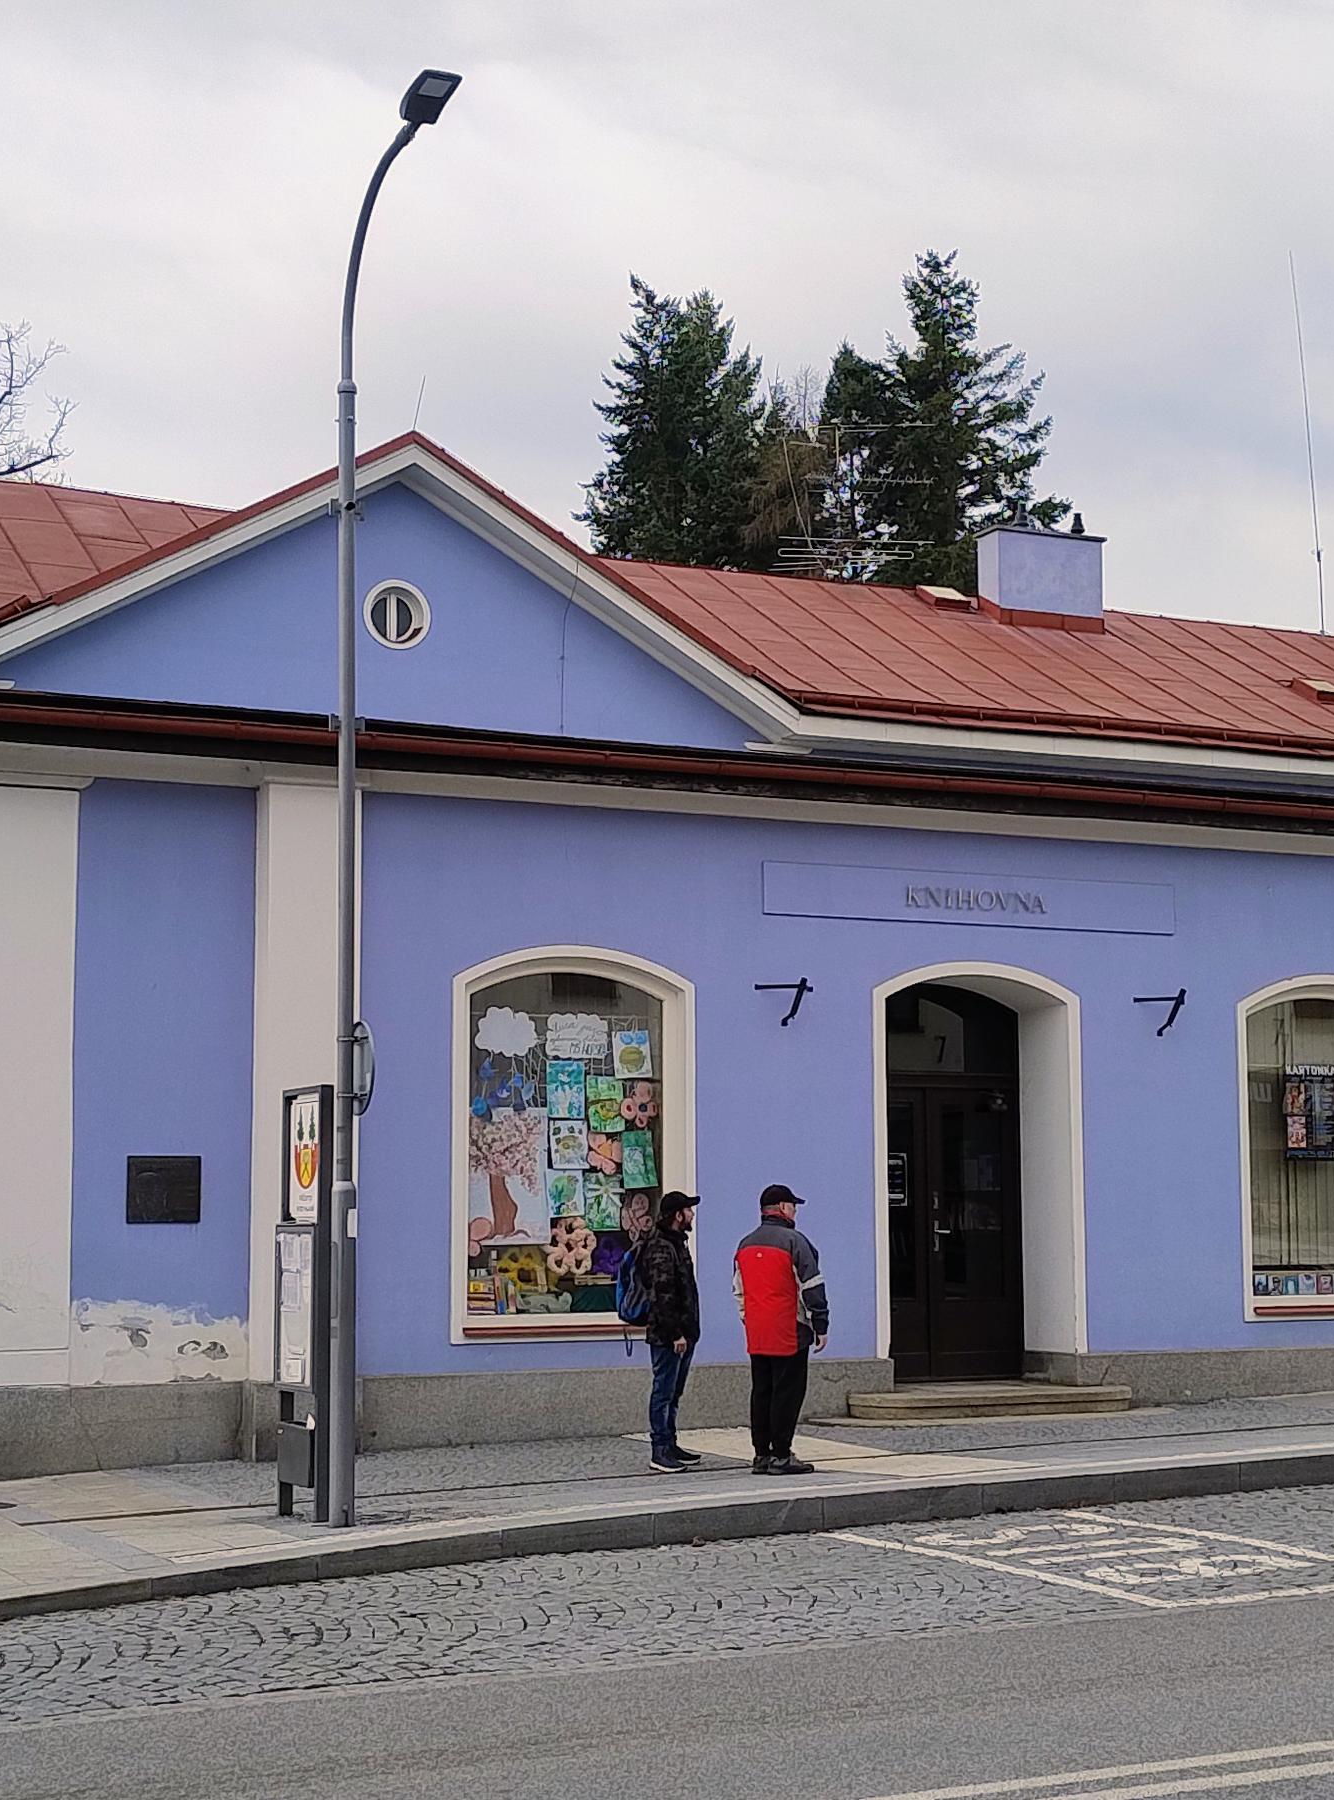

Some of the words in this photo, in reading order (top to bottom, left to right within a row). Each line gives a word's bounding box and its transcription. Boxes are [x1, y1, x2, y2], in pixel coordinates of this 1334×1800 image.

[906, 884, 1048, 914] KNIHOVNA
[934, 1035, 947, 1063] 7
[914, 1523, 1318, 1586] BUS
